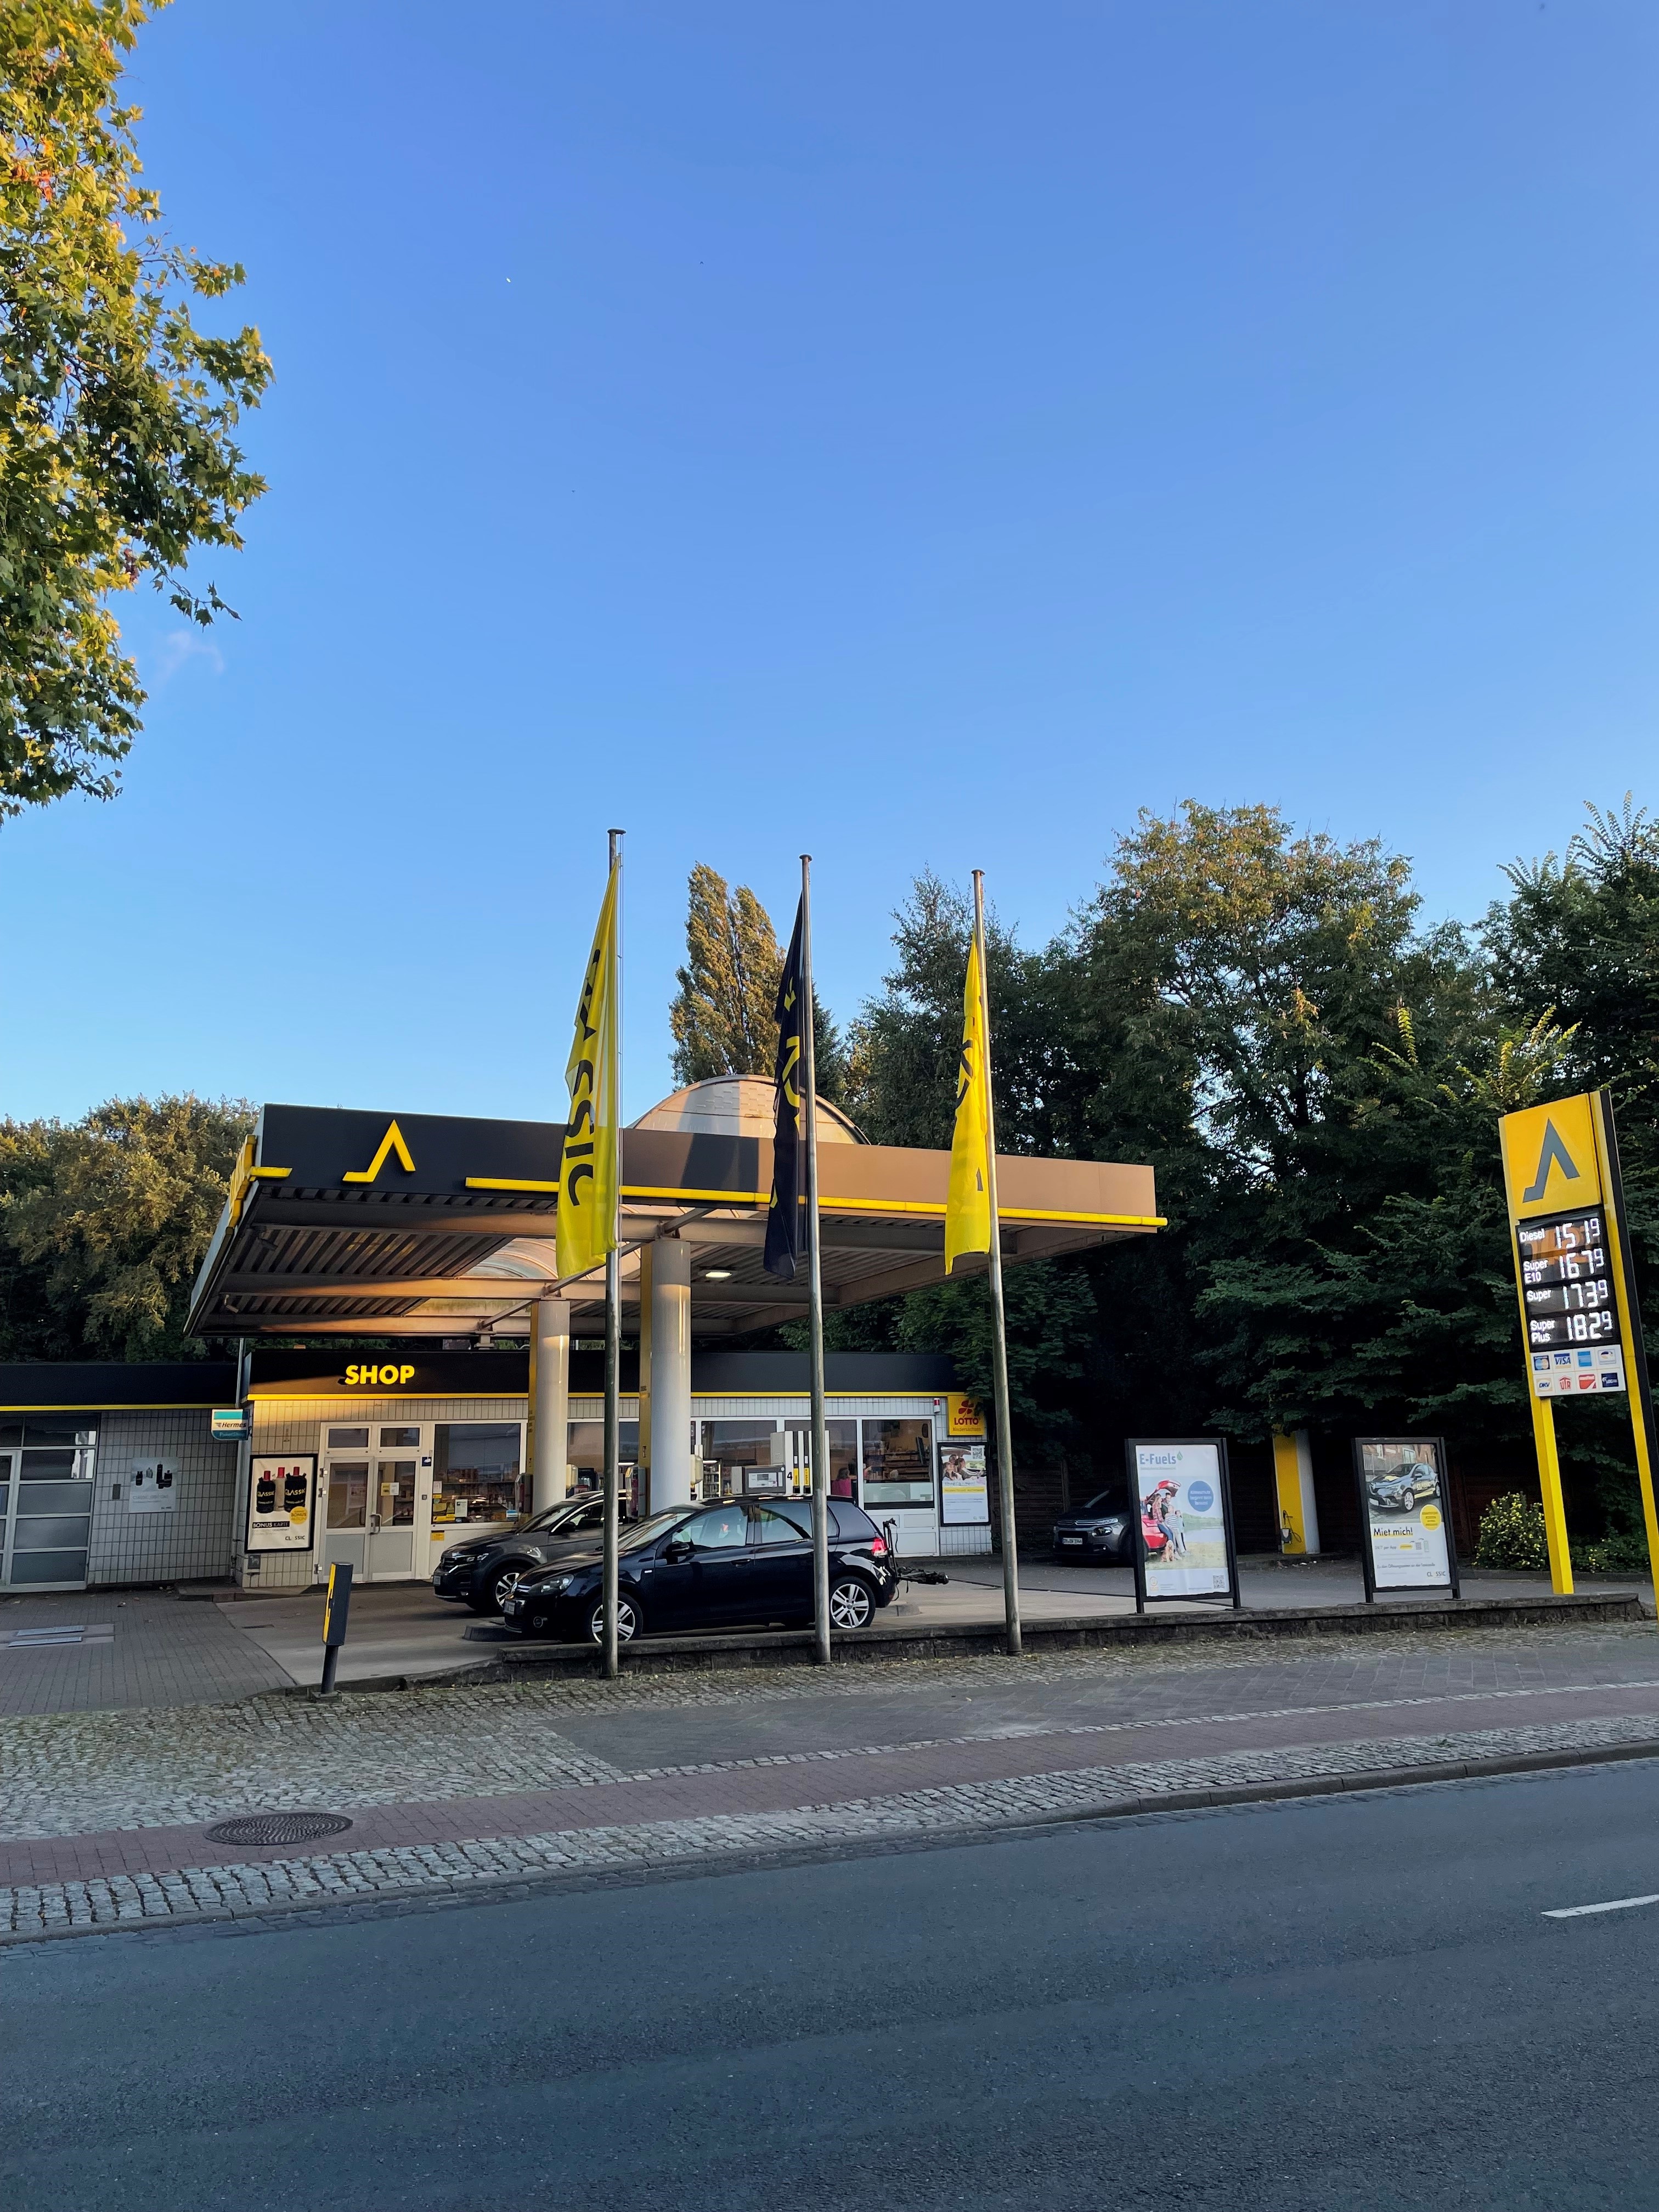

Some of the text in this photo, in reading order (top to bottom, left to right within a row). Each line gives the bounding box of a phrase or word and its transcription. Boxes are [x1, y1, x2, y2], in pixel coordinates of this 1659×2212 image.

[1520, 1228, 1545, 1243] Diesel
[1523, 1260, 1548, 1272] Super
[1525, 1272, 1542, 1284] E10
[1527, 1290, 1551, 1302] Super
[1530, 1320, 1556, 1331] Super
[1531, 1331, 1551, 1343] Plus
[1555, 1357, 1571, 1365] VISA
[345, 1365, 415, 1385] SHOP
[1139, 1453, 1177, 1465] E-Fuels
[787, 1472, 793, 1480] 4
[1374, 1526, 1413, 1536] Miet mich!
